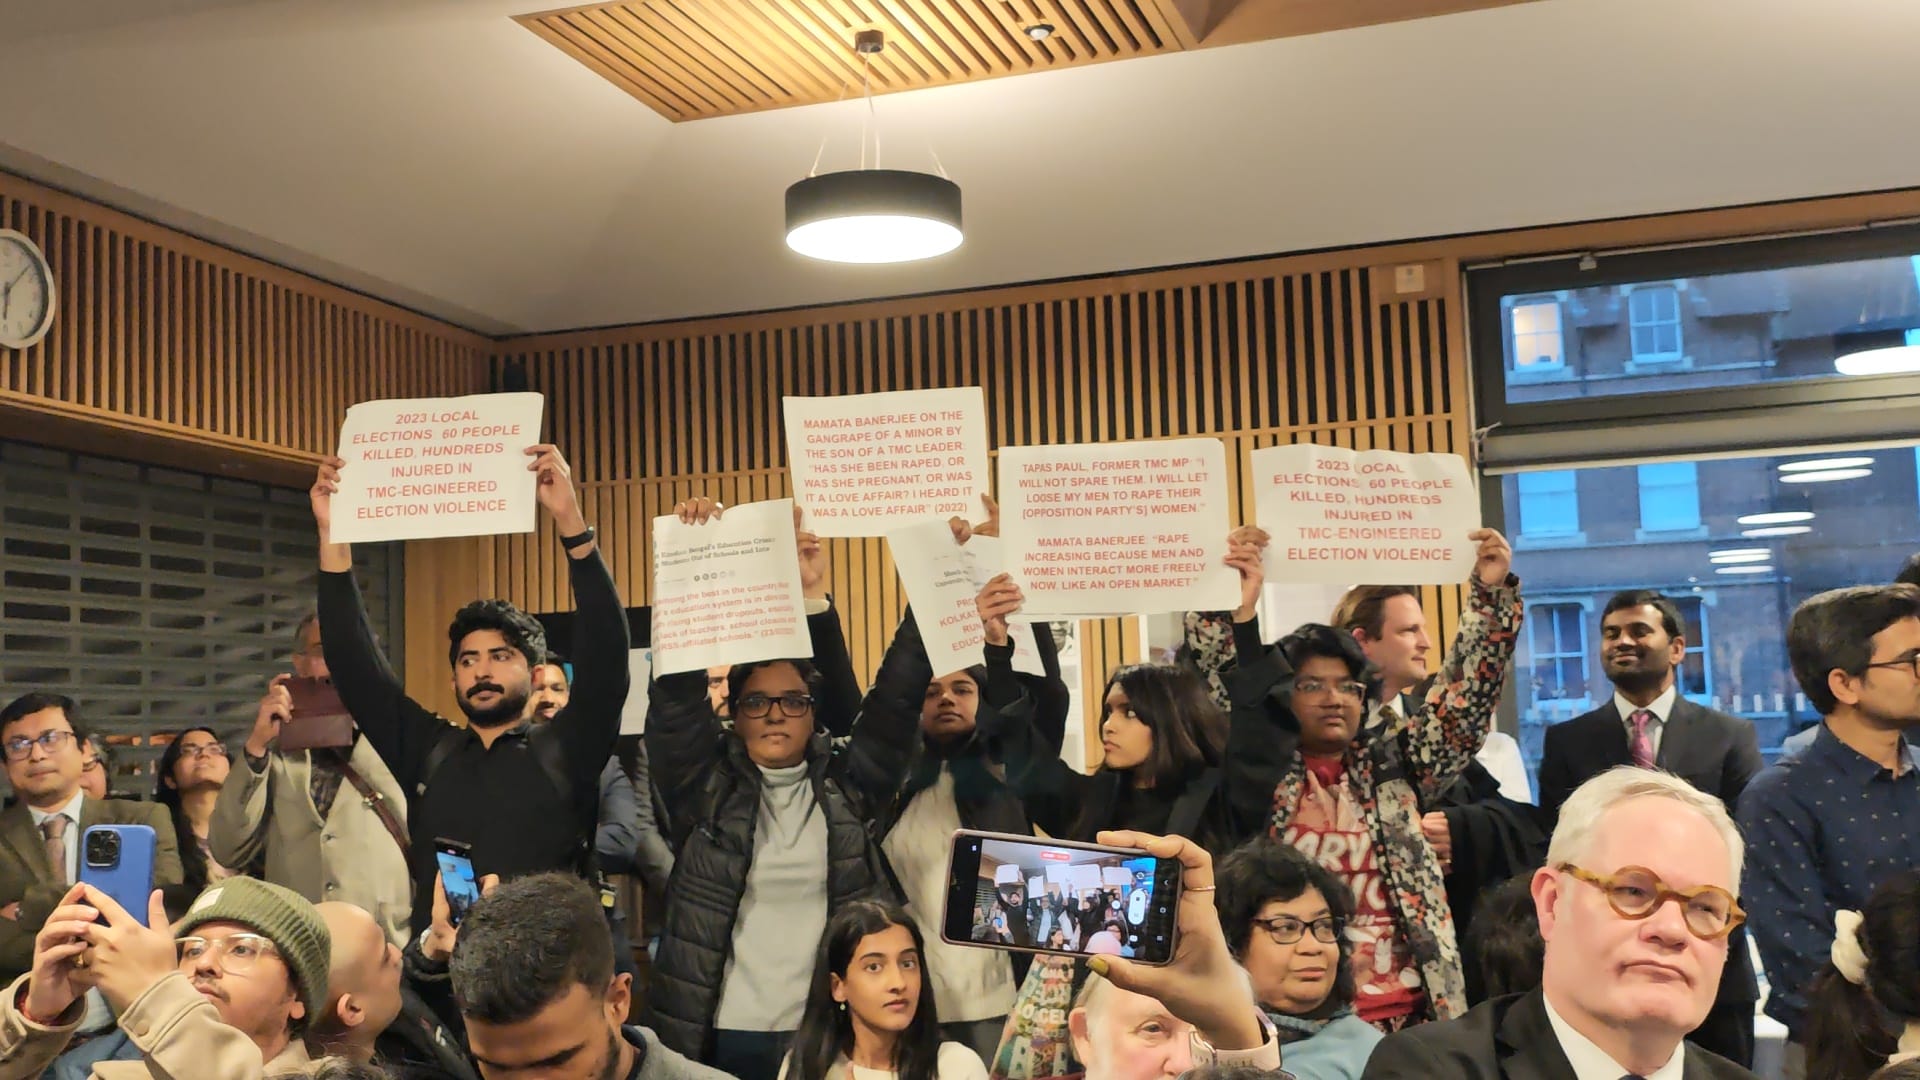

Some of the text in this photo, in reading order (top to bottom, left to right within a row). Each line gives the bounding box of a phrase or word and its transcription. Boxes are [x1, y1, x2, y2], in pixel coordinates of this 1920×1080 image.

[396, 410, 479, 424] 2023 LOCAL
[804, 411, 964, 429] MAMATA BANERJEE ON THE
[442, 428, 456, 439] 60
[462, 425, 520, 437] PEOPLE
[807, 426, 962, 443] GANGRAPE OF A MINOR BY
[422, 443, 504, 457] HUNDREDS
[806, 449, 826, 458] THE
[830, 448, 854, 458] SON
[858, 447, 873, 457] OF
[877, 446, 884, 455] A
[888, 444, 912, 455] TMC
[392, 463, 472, 478] INJURED IN
[841, 463, 863, 472] SHE
[868, 459, 898, 471] BEEN
[948, 457, 965, 466] OR
[1023, 463, 1052, 473] TAPAS
[1092, 460, 1140, 470] FORMER
[1145, 459, 1168, 469] TMC
[1317, 460, 1404, 473] 2023 LOCAL
[804, 478, 828, 488] WAS
[832, 478, 854, 487] SHE
[926, 473, 944, 483] OR
[947, 472, 973, 481] WAS
[1019, 477, 1044, 488] WILL
[1044, 477, 1067, 487] NOT
[1071, 475, 1108, 486] SPARE
[1150, 474, 1153, 483] I
[1156, 474, 1184, 483] WILL
[1188, 473, 1208, 482] LET
[1369, 479, 1386, 488] 60
[1391, 478, 1452, 490] PEOPLE
[367, 481, 497, 499] TMC-ENGINEERED
[806, 486, 973, 502] IT A LOVE AFFAIR? I HEARD IT
[1027, 488, 1201, 503] LOOSE MY MEN TO RAPE THEIR
[1355, 494, 1441, 504] HUNDREDS
[357, 500, 507, 519] ELECTION VIOLENCE
[813, 507, 837, 517] WAS
[841, 508, 849, 516] A
[852, 506, 882, 516] LOVE
[935, 503, 968, 513] (2022)
[1325, 509, 1413, 521] INJURED IN
[1299, 527, 1441, 539] TMC-ENGINEERED
[1038, 536, 1082, 547] MAMATA
[1025, 548, 1204, 561] INCREASING BECAUSE MEN AND
[1287, 547, 1452, 560] ELECTION VIOLENCE
[1023, 562, 1206, 576] WOMEN INTERACT MORE FREELY
[1062, 580, 1086, 589] LIKE
[1090, 580, 1105, 589] AN
[1109, 579, 1140, 588] OPEN
